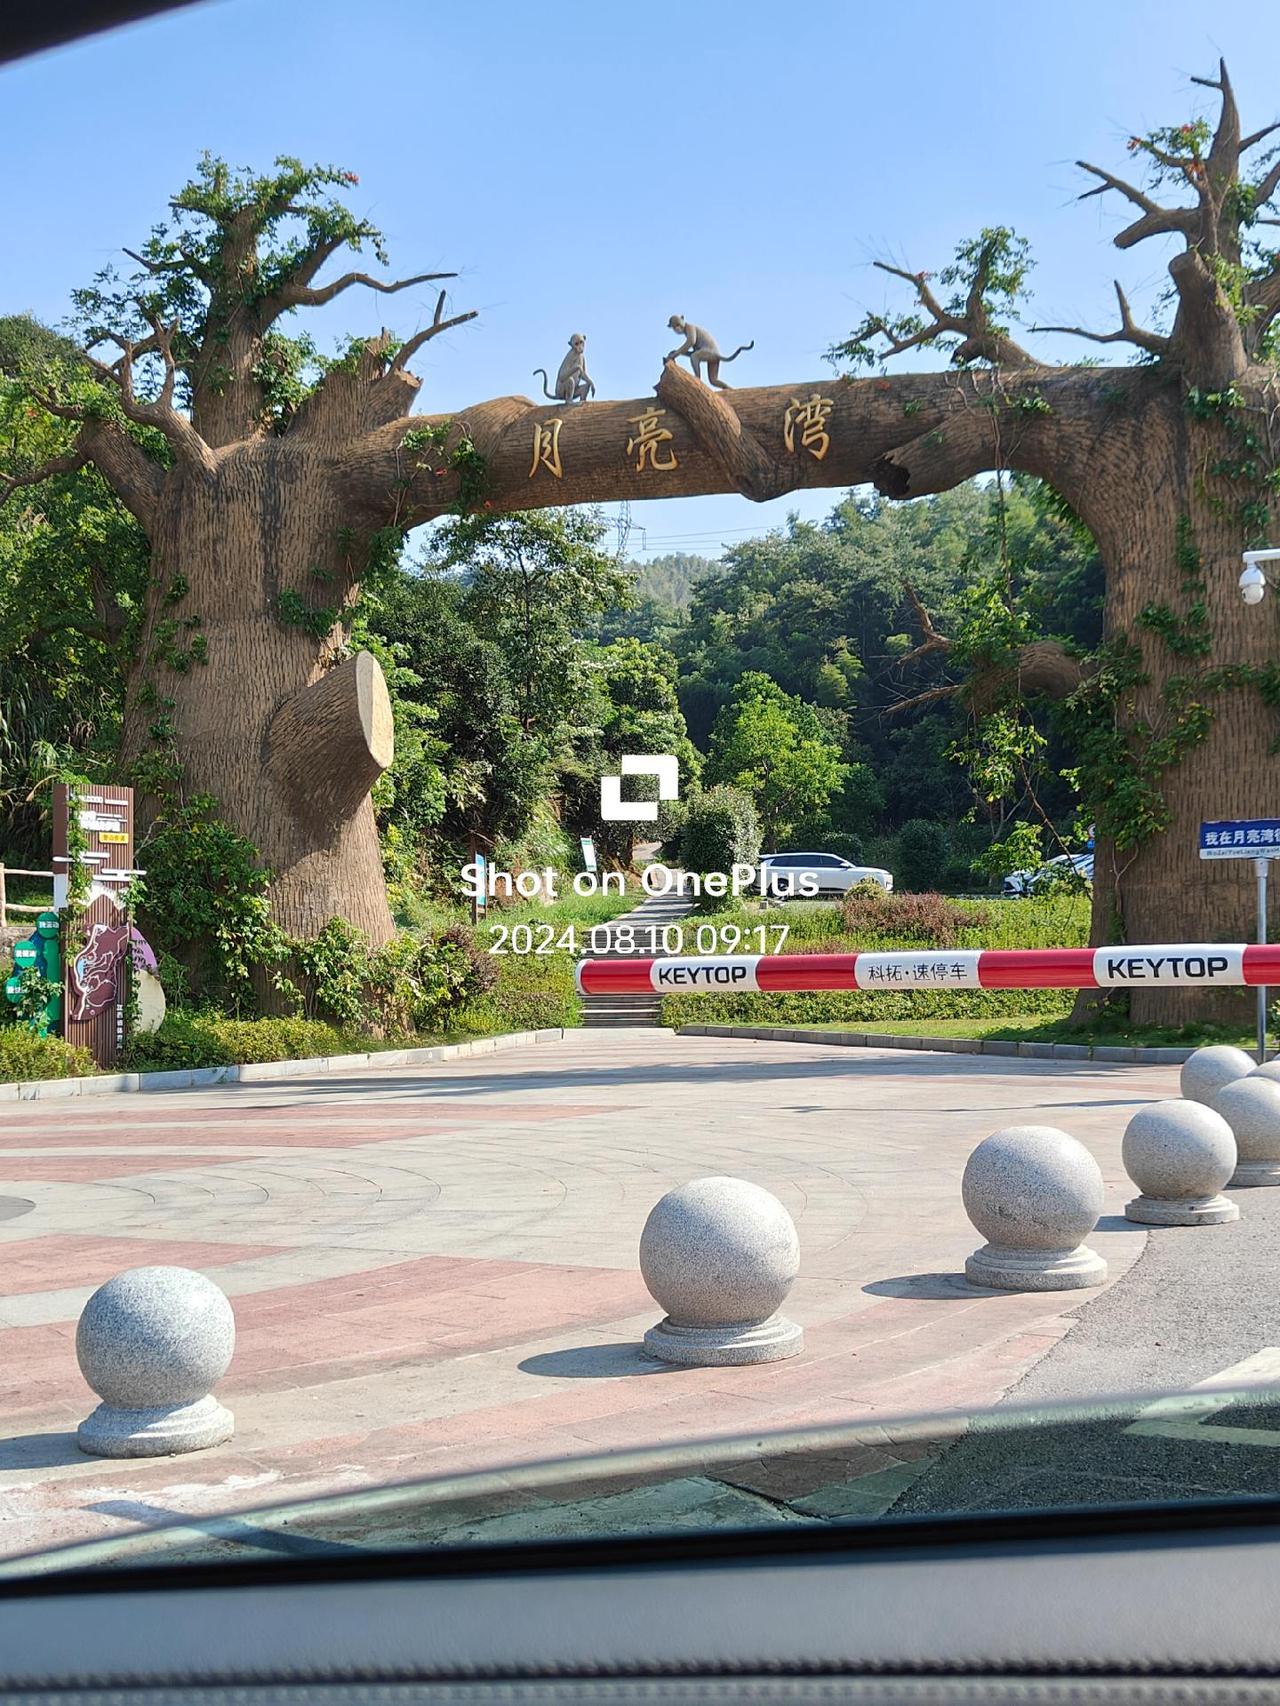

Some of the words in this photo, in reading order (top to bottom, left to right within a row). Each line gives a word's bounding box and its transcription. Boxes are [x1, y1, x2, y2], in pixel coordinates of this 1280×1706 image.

[528, 393, 834, 479] 月亮湾
[658, 965, 747, 985] KEYTOP
[1107, 956, 1229, 980] KEYTOP
